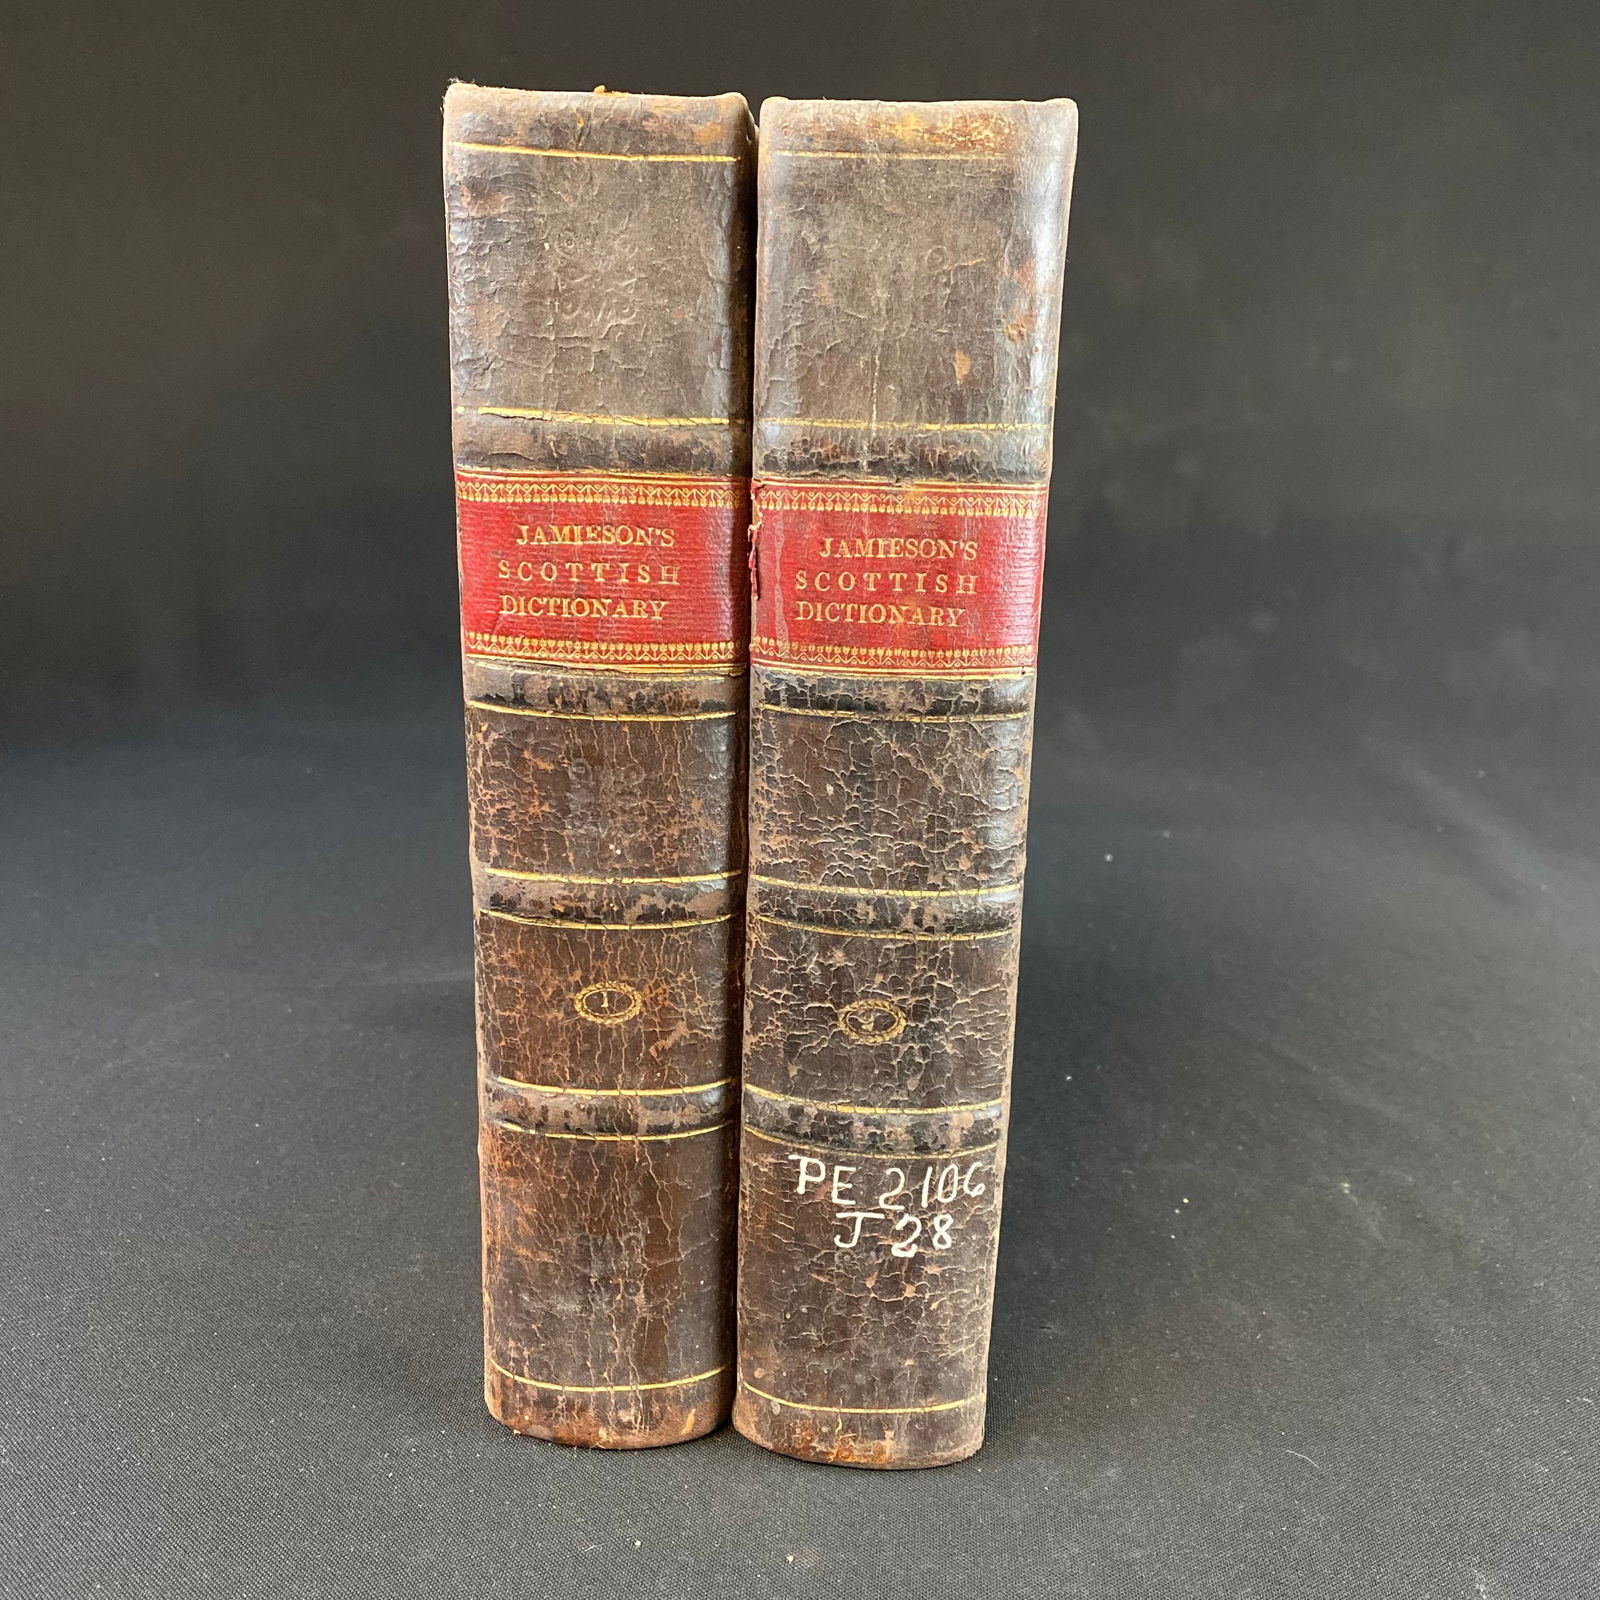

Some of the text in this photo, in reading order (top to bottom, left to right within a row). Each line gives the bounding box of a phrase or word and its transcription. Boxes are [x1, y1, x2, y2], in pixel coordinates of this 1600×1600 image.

[516, 525, 675, 547] JAMIESON'S
[819, 537, 977, 560] JAMIESON'S
[498, 560, 680, 584] SCOTTISH
[795, 570, 977, 595] SCOTTISH
[499, 595, 668, 620] DICTIONARY
[794, 601, 966, 627] DICTIONARY
[788, 1154, 986, 1210] PE 2106
[891, 1213, 954, 1257] 28
